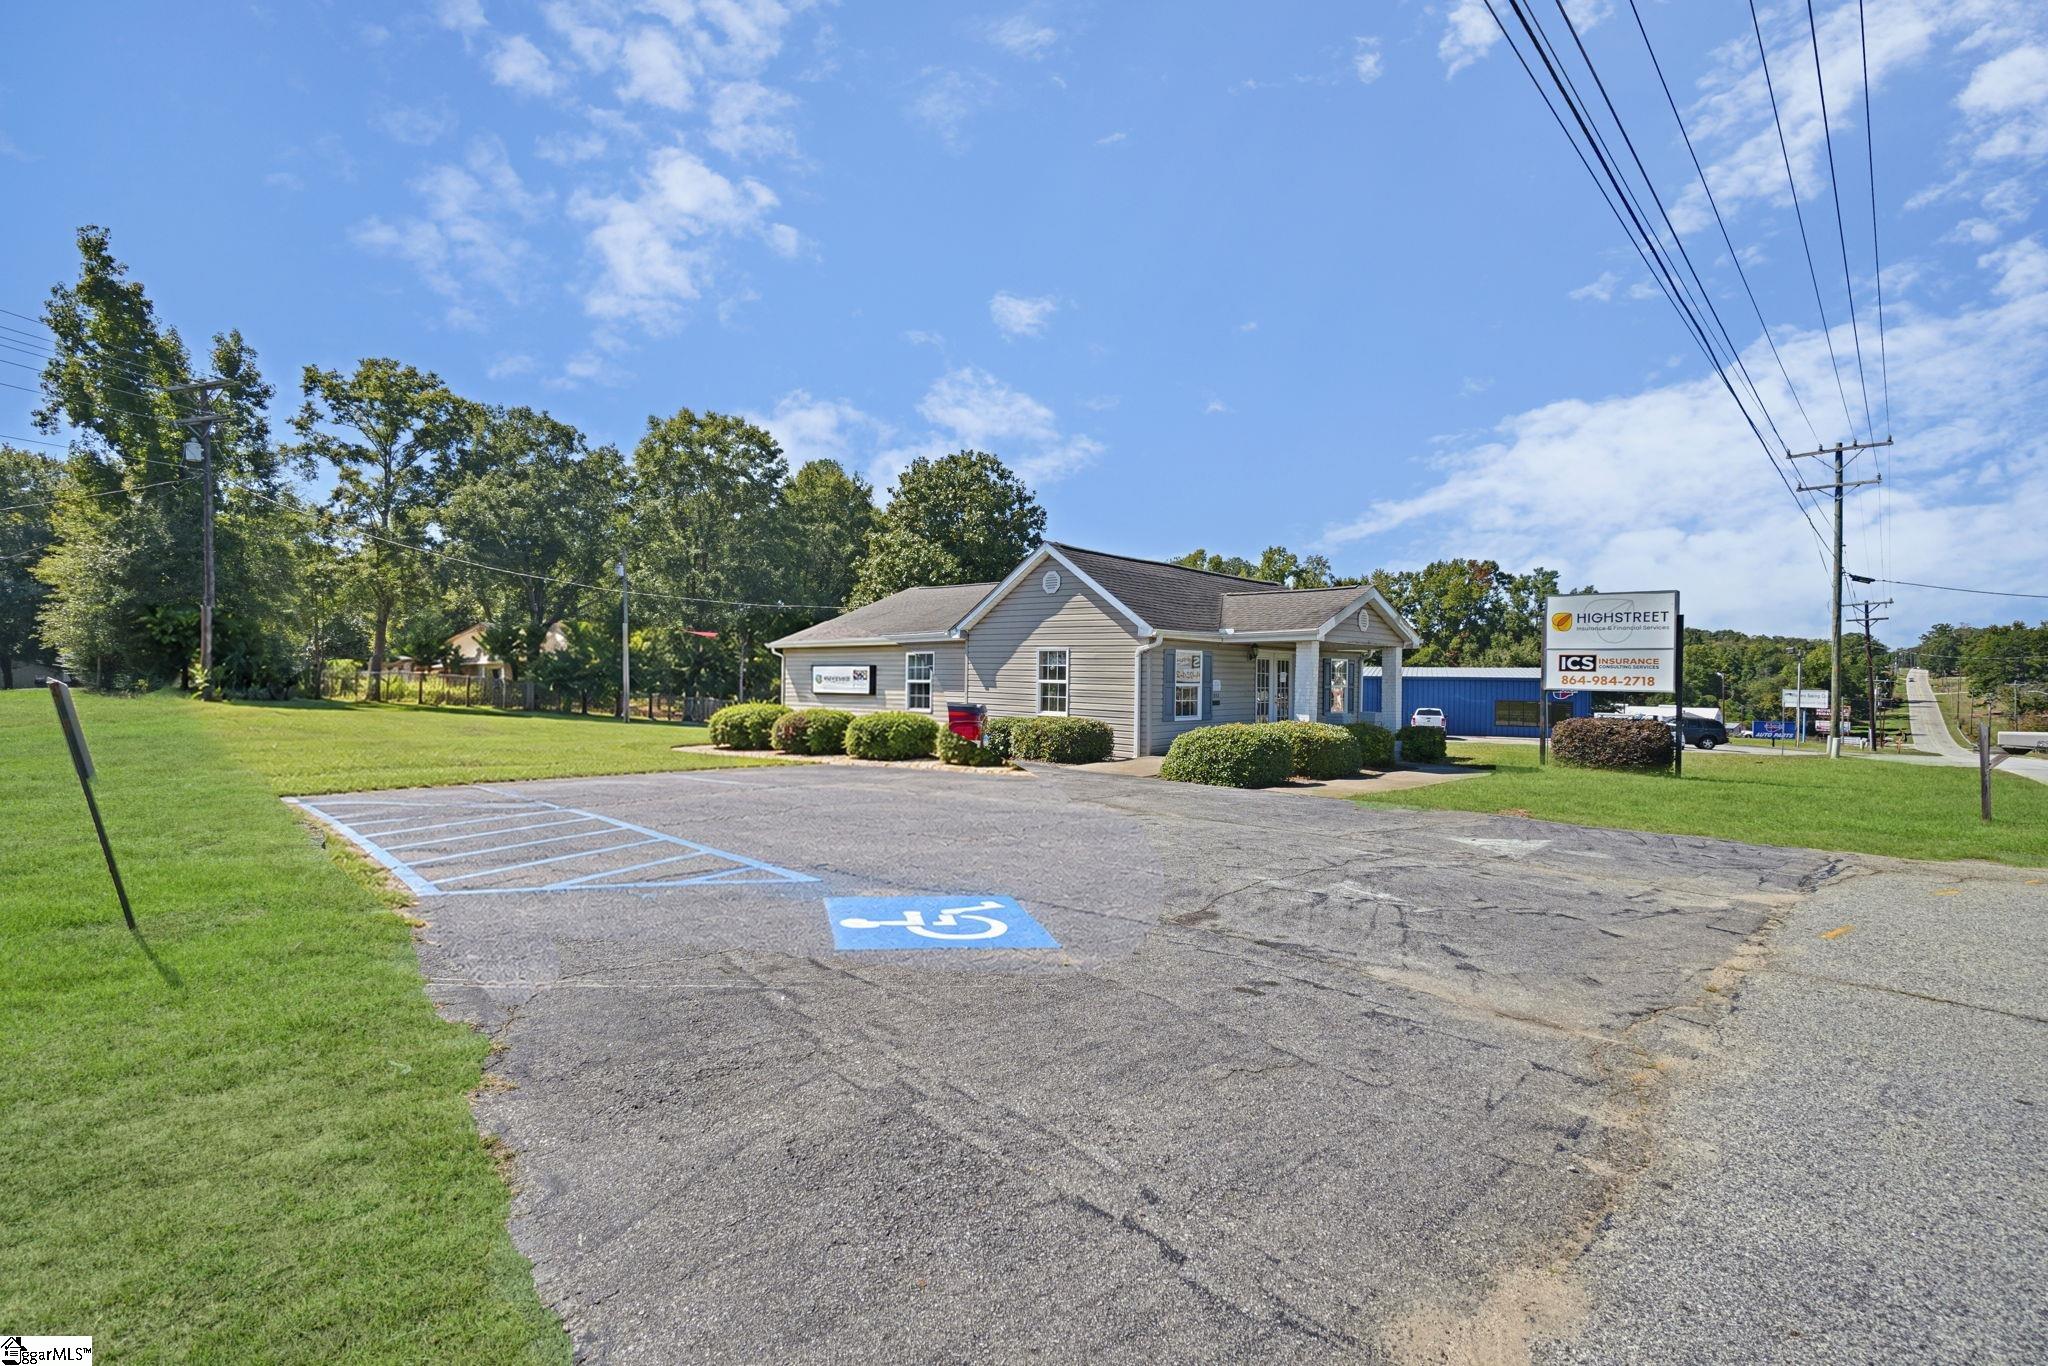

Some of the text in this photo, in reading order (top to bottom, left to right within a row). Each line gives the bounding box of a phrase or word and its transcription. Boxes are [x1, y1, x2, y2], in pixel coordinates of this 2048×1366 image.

[1576, 611, 1670, 624] HIGHSTREET
[1561, 656, 1595, 671] ICS
[1561, 675, 1655, 687] 864-984-2718
